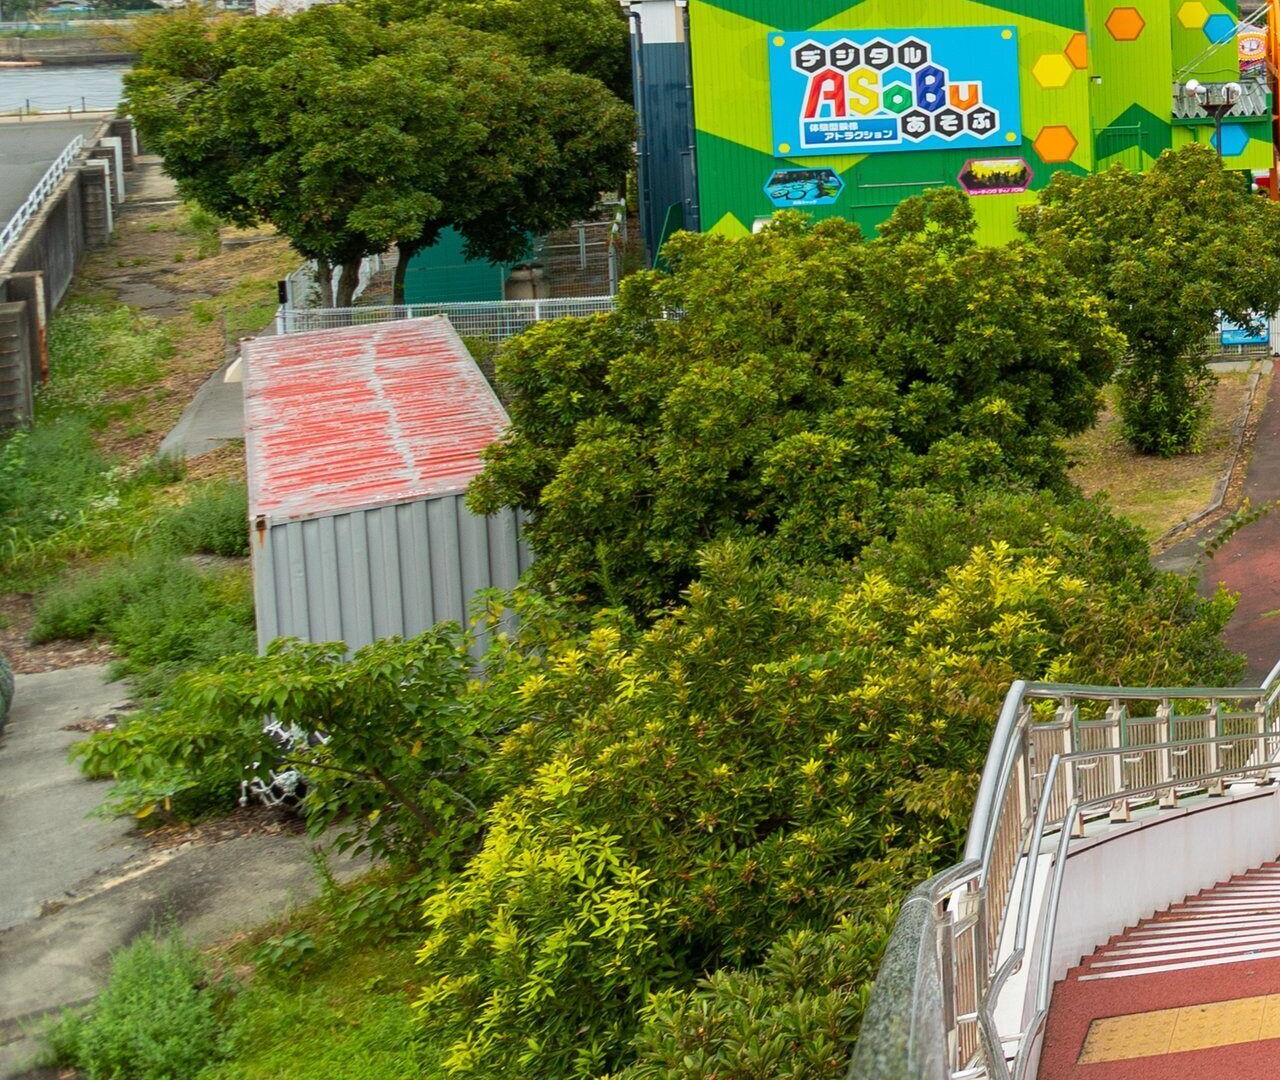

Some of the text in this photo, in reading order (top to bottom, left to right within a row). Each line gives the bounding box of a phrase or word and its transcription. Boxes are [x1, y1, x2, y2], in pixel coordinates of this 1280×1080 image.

[800, 46, 922, 67] デジタル
[906, 112, 992, 133] あそぶ
[824, 130, 893, 142] アトラクション
